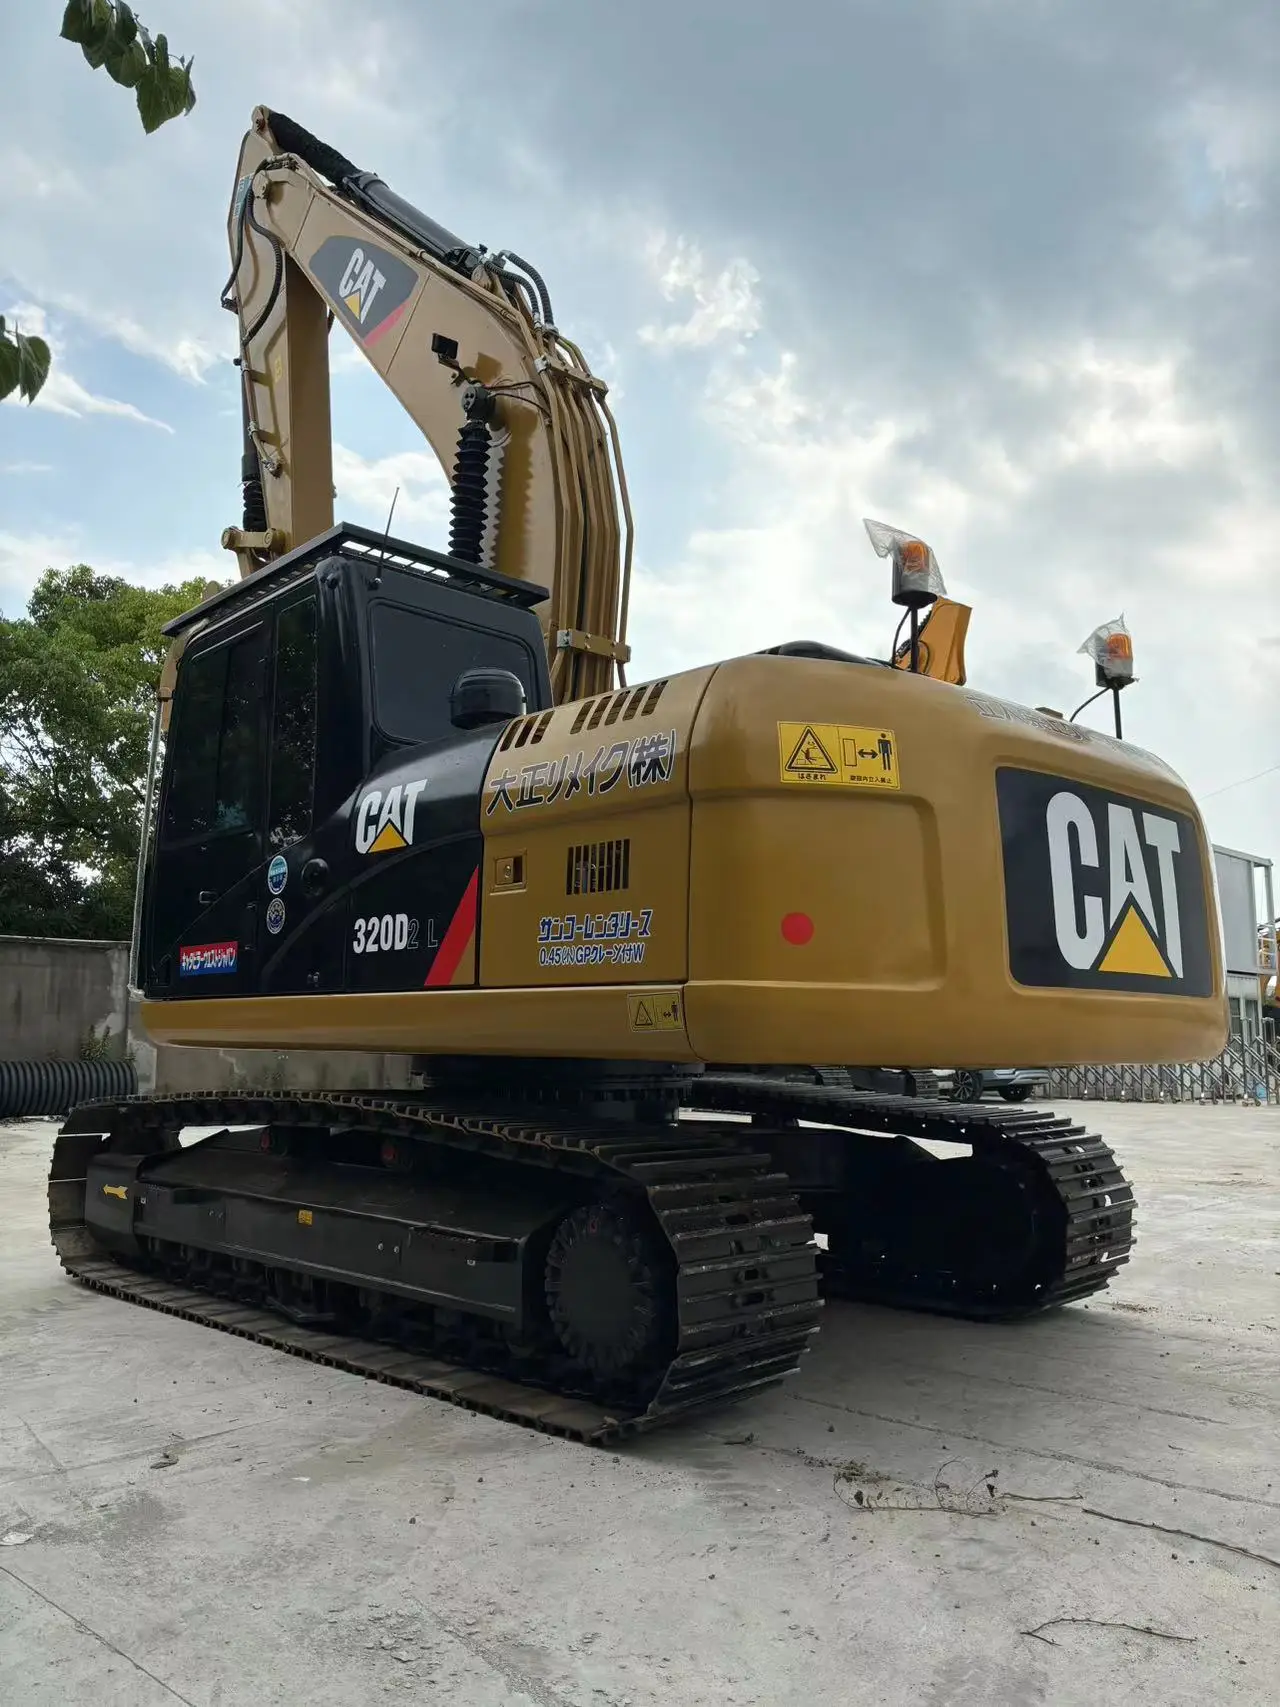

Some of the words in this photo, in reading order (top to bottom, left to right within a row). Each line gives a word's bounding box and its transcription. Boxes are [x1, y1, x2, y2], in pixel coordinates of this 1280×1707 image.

[339, 248, 387, 324] CAT
[486, 728, 677, 815] 大正リメイク(株)
[355, 779, 427, 855] CAT
[1046, 791, 1184, 979] CAT
[537, 909, 653, 942] サンコーレンタリース
